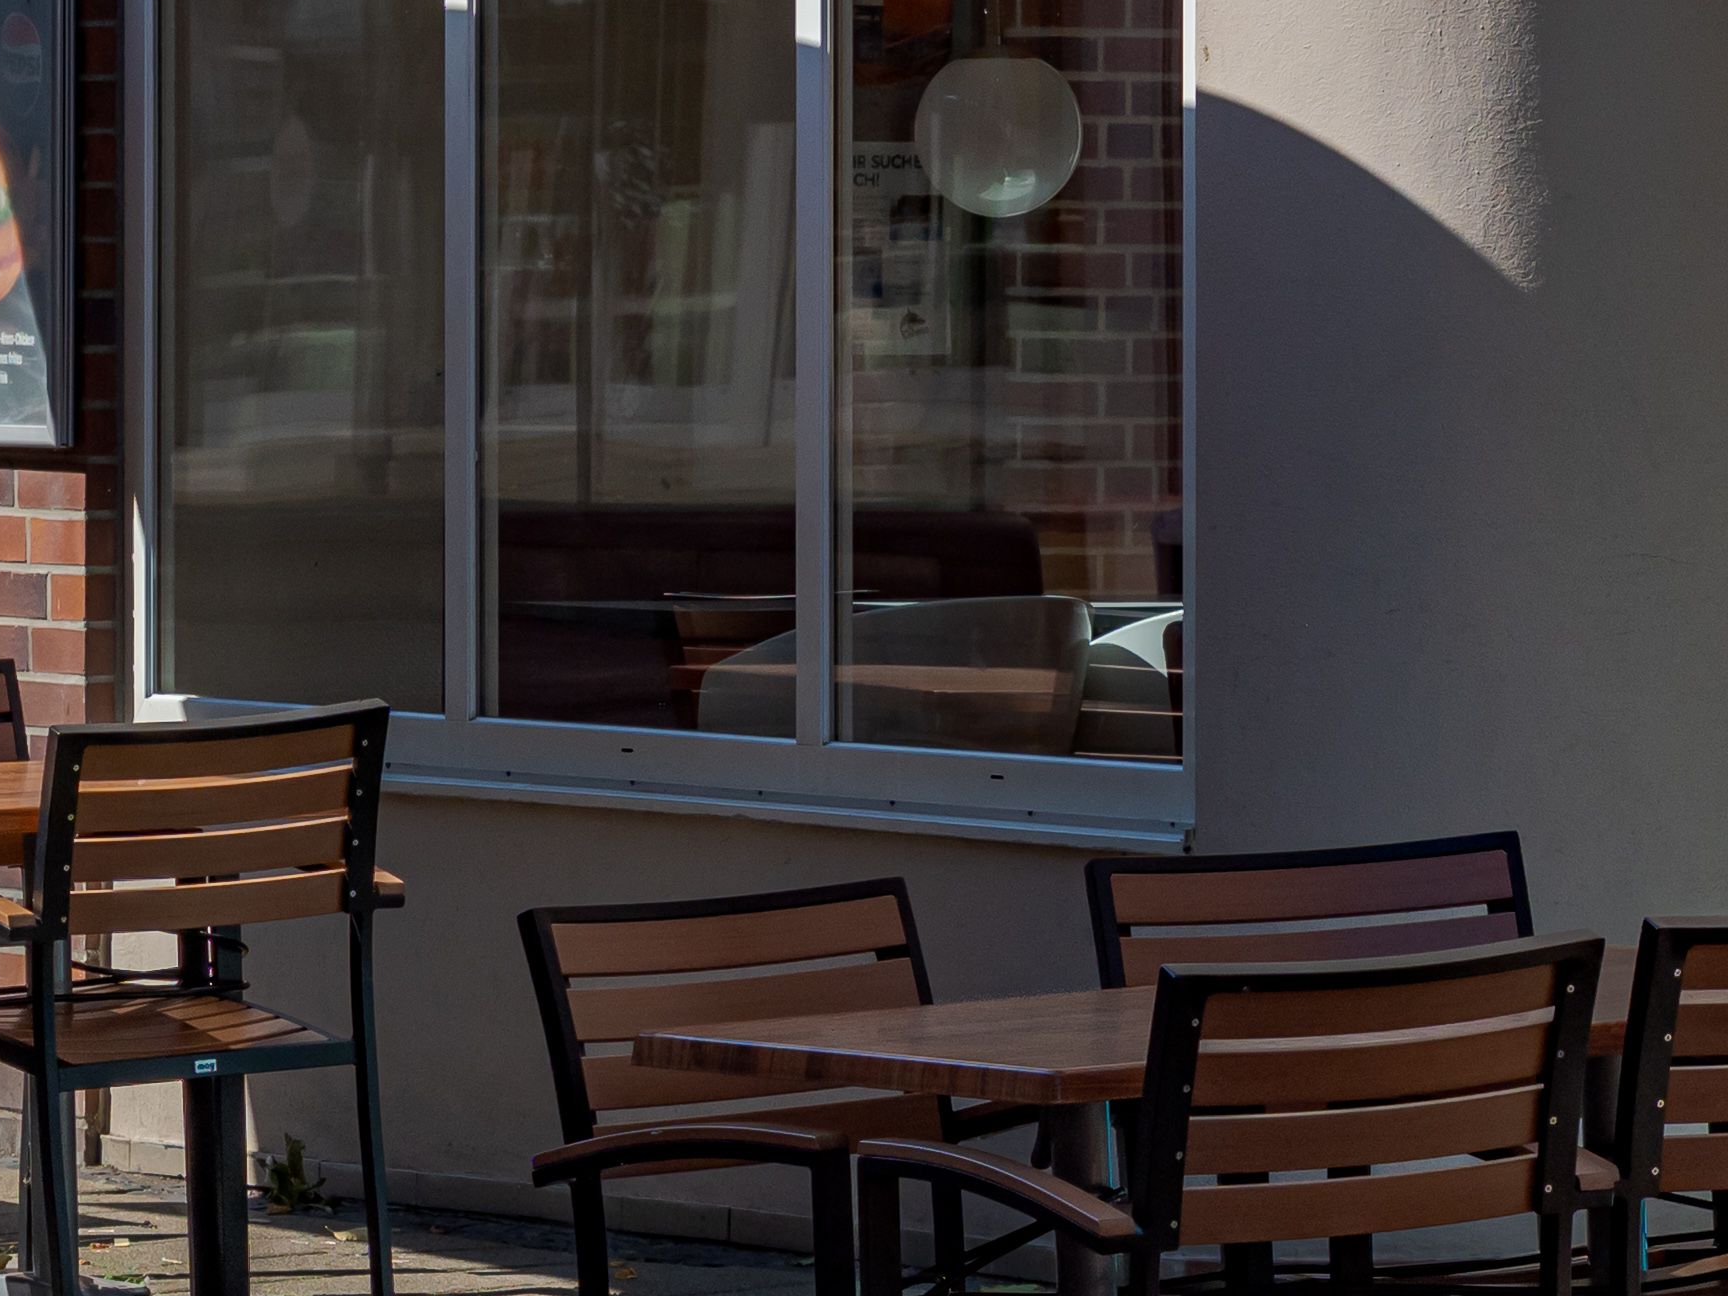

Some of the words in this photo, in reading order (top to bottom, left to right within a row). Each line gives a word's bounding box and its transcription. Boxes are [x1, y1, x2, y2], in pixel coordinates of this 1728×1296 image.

[854, 154, 866, 169] IR
[871, 154, 923, 169] SUCHE
[854, 173, 880, 187] CH!
